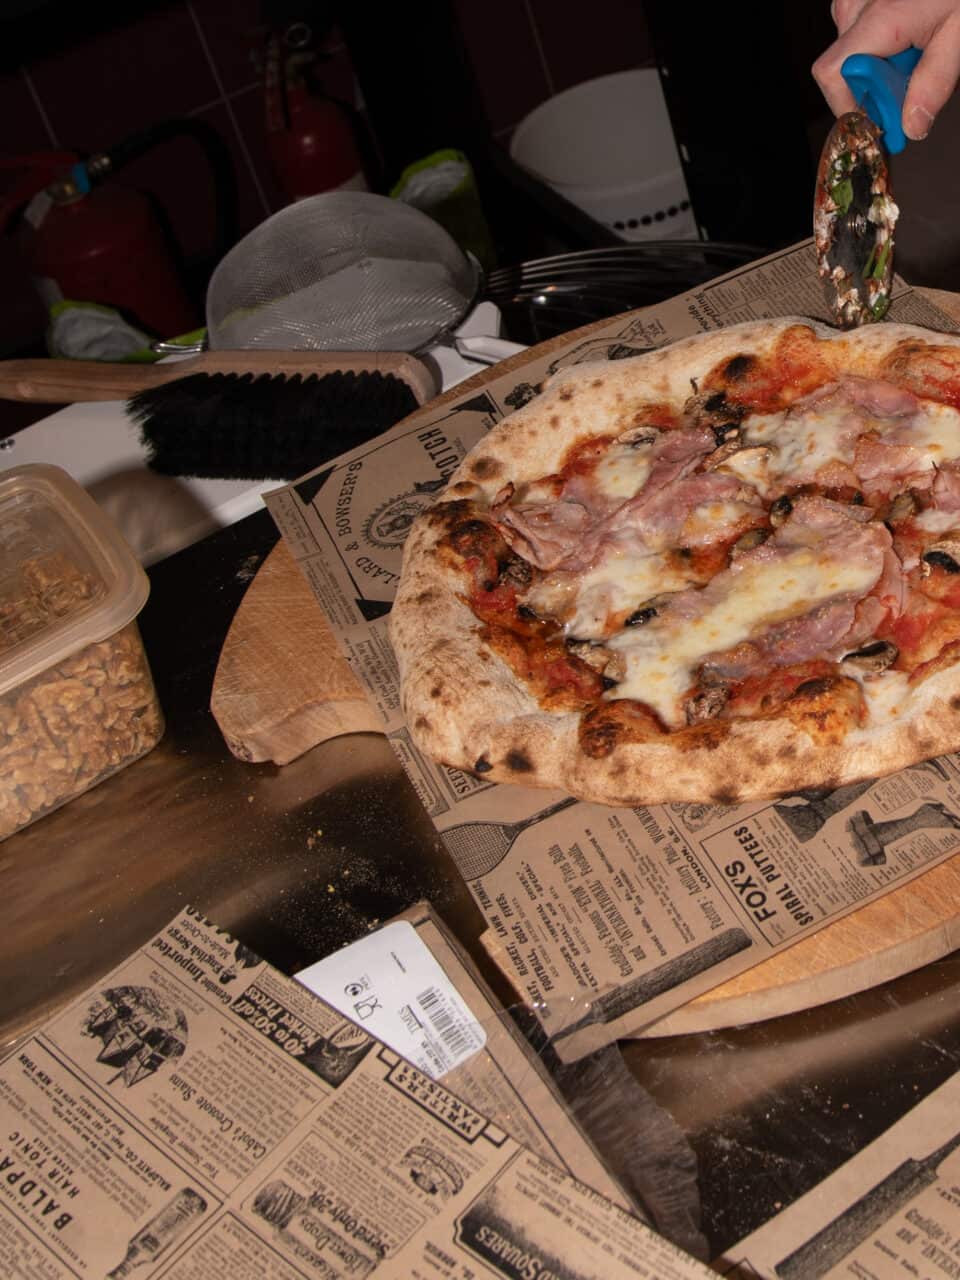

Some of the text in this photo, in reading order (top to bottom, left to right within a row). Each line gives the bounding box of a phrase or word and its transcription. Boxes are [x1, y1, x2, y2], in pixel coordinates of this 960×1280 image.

[688, 305, 710, 332] rovide
[417, 428, 460, 480] COTCH
[335, 458, 363, 537] BOWSER'S
[548, 844, 566, 865] Balls
[559, 862, 577, 883] Fives
[681, 846, 711, 889] LONDON,
[734, 826, 781, 883] PUTTEES
[675, 864, 702, 896] Artillery
[724, 860, 777, 923] FOX'S
[588, 910, 612, 941] Famous
[697, 896, 725, 931] Factory:
[776, 883, 814, 926] SPIRAL
[152, 937, 205, 982] Imported
[167, 927, 224, 974] English Serge
[495, 893, 554, 992] FOOTBALL, GOLF, FIVES,
[628, 945, 647, 962] and
[241, 983, 285, 1017] Prices
[268, 1026, 292, 1043] to
[278, 1036, 309, 1059] 40
[169, 1073, 267, 1159] Cabot's Creosote Stains
[395, 1074, 472, 1134] WRITERS
[411, 1071, 473, 1119] ARTISTS
[8, 1132, 80, 1199] HAIR TONIC
[0, 1156, 73, 1231] BALDPA
[473, 1222, 546, 1280] SQUARES
